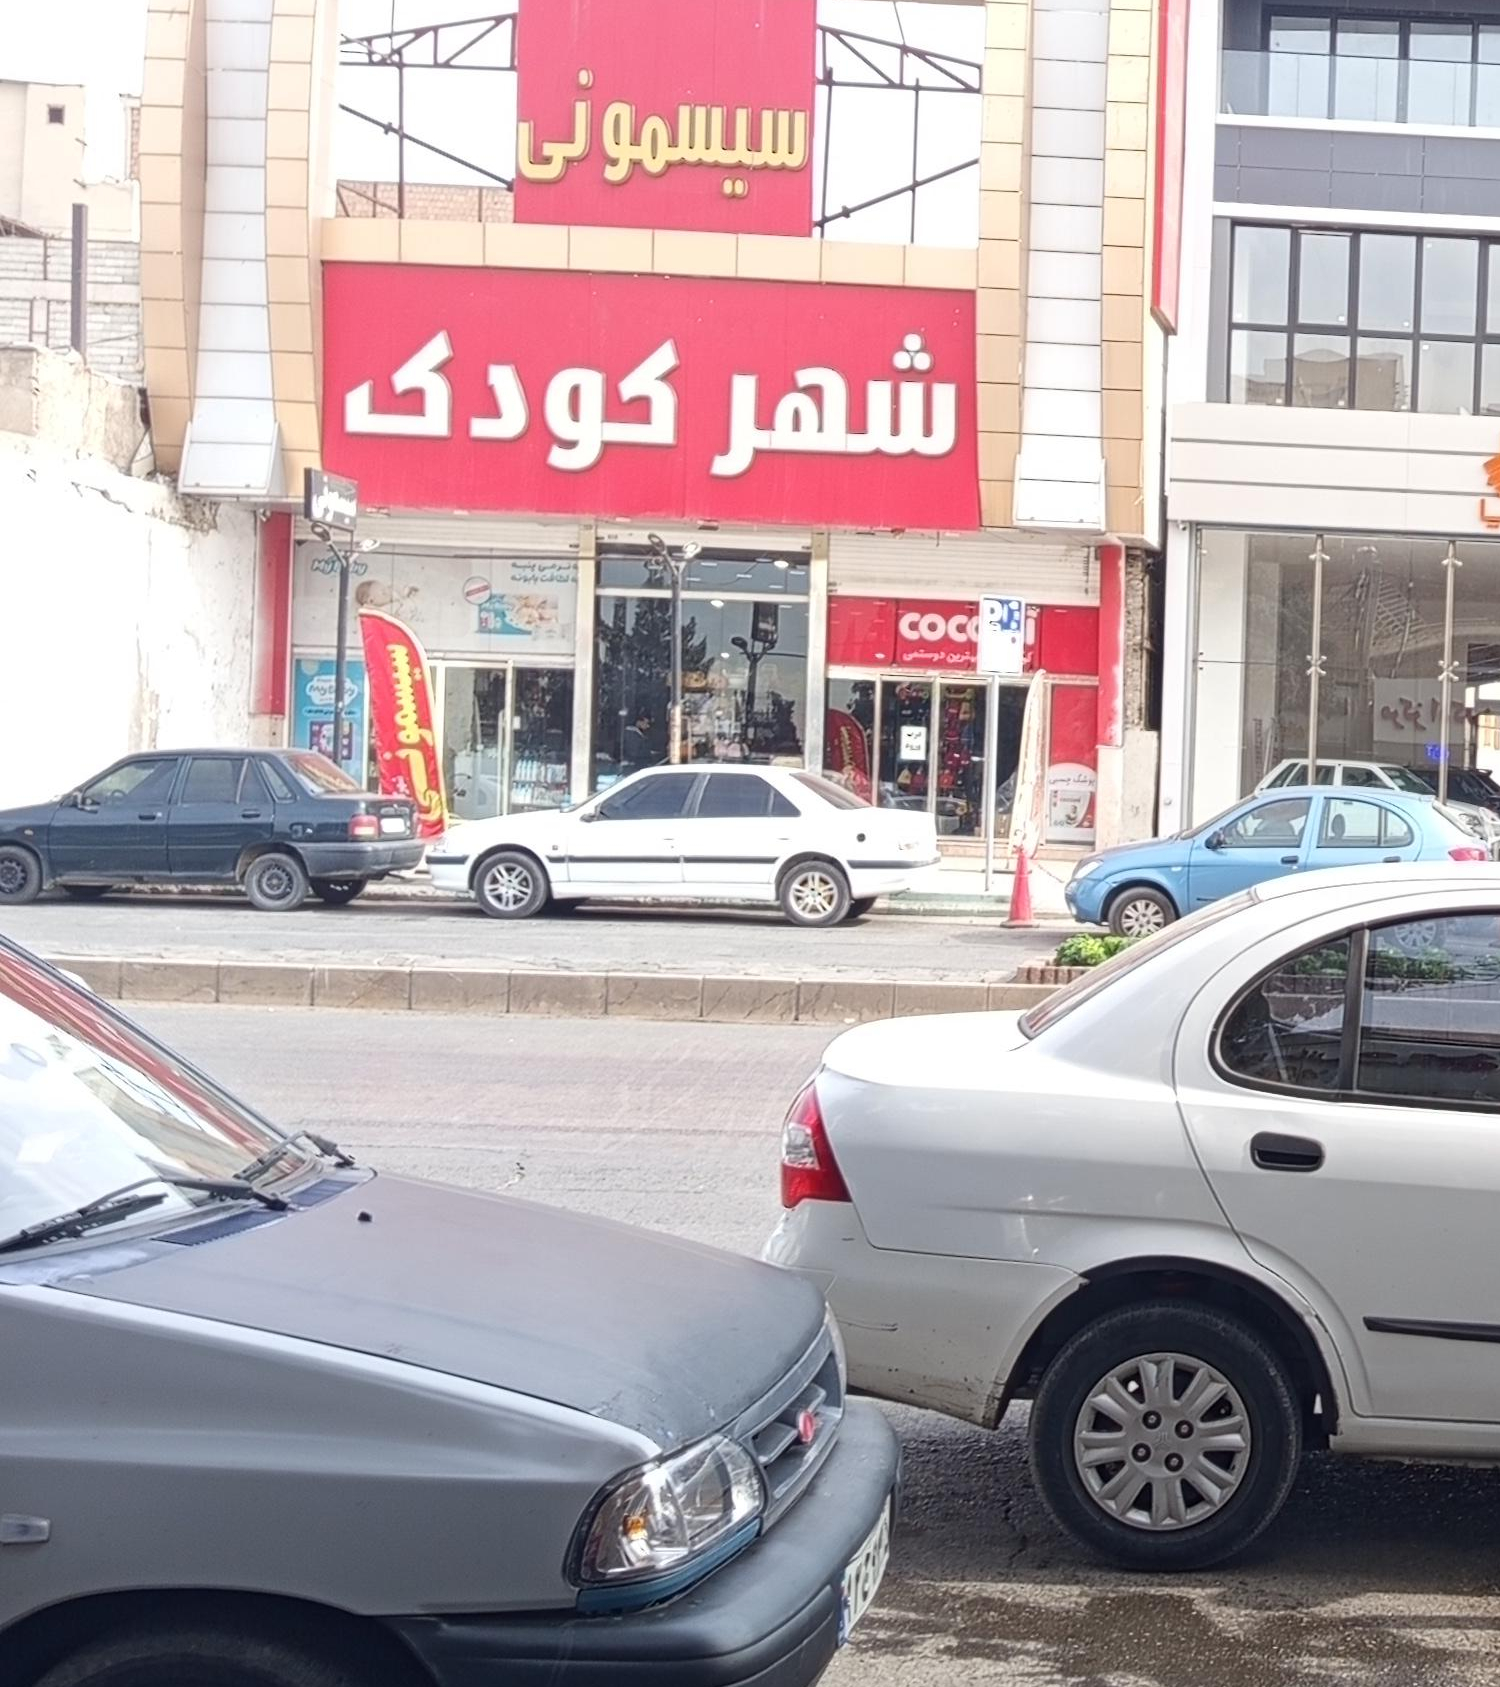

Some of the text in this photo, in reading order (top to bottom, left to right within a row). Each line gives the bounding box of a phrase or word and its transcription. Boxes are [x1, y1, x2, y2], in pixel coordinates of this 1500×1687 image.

[517, 67, 808, 198] سیسمونی
[345, 330, 958, 478] شهر کودک
[383, 644, 443, 822] سیسمونی
